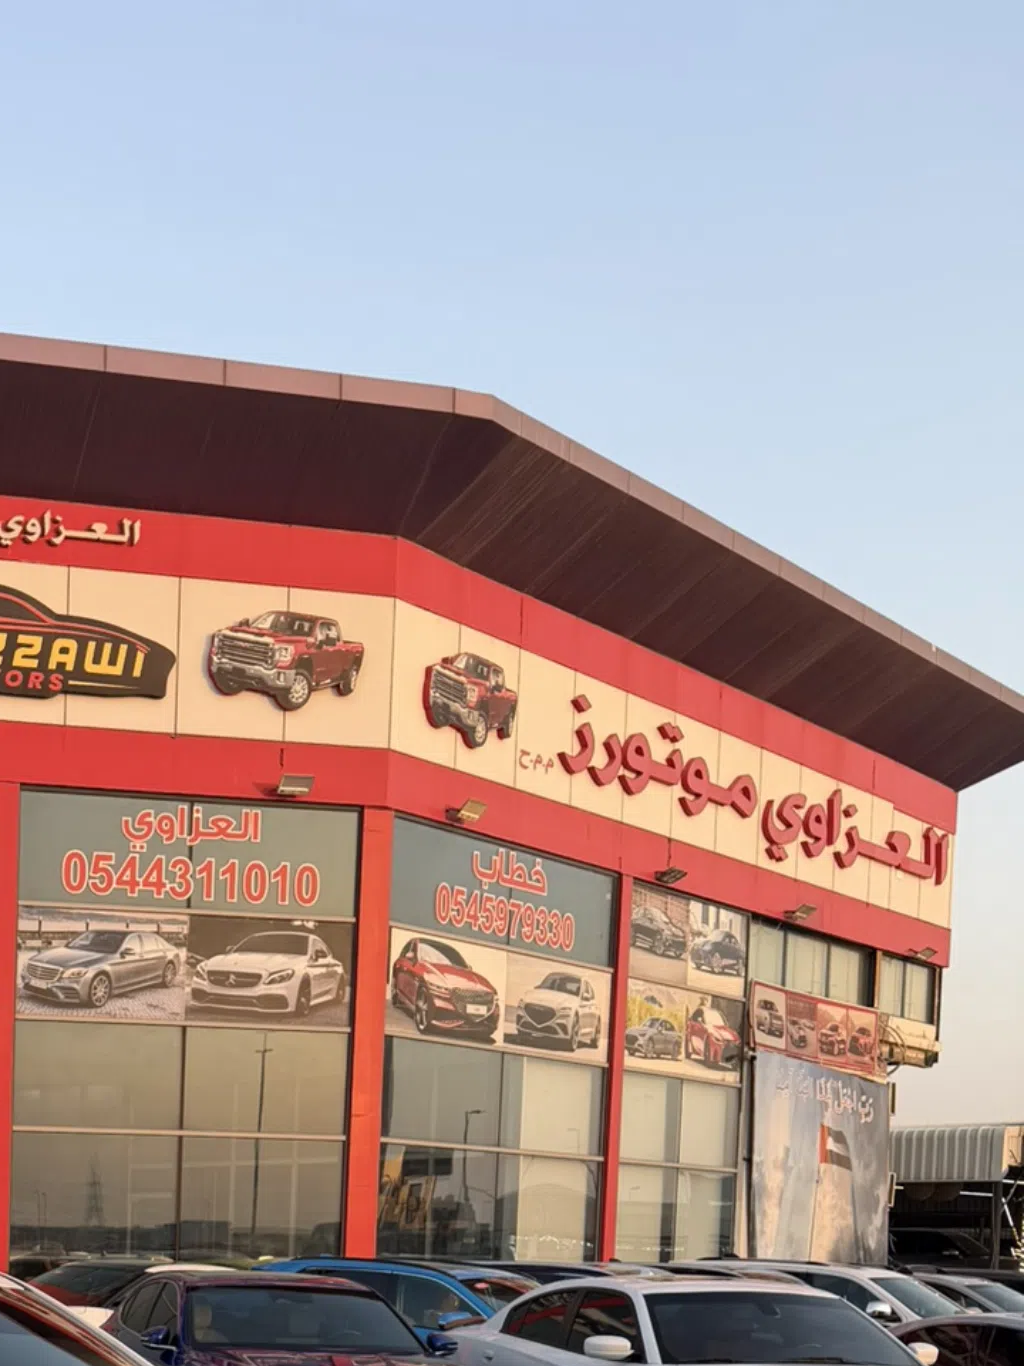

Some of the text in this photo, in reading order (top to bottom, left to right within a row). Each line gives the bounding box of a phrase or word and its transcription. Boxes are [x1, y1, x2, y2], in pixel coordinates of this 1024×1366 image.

[557, 694, 758, 818] موتورز
[121, 804, 262, 852] العزاوي
[760, 788, 949, 886] العزاوي
[61, 849, 321, 907] 0544311010
[472, 847, 548, 896] خطاب
[435, 882, 576, 952] 0545979330
